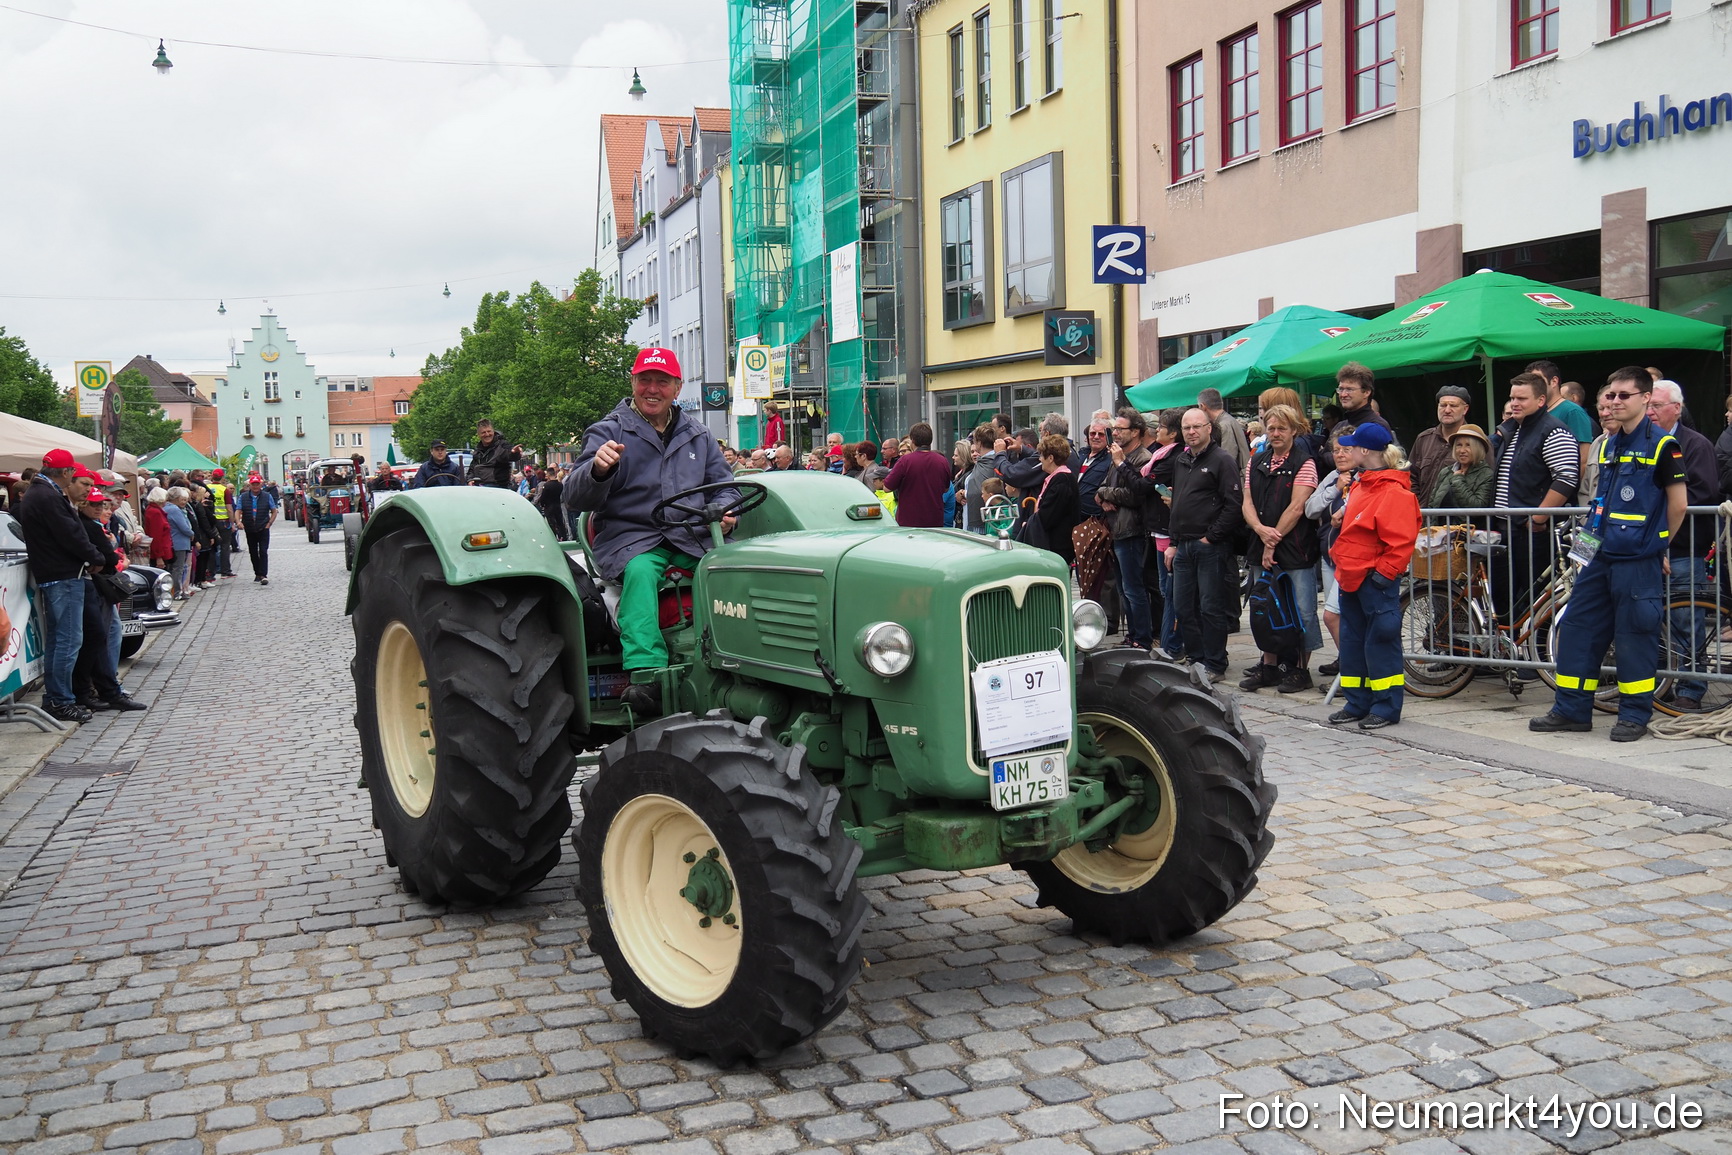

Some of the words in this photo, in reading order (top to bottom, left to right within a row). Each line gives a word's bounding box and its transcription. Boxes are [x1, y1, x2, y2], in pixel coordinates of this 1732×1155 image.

[1572, 92, 1732, 159] Buchhan
[1151, 300, 1169, 311] Unterer
[1169, 296, 1184, 307] Markt
[1184, 293, 1191, 305] 15
[1535, 316, 1645, 327] Lammsbräu
[1537, 310, 1615, 318] Neumarkter
[1065, 325, 1083, 347] G2
[1338, 330, 1429, 351] Lammsbräu
[643, 356, 667, 365] DEKRA
[752, 354, 761, 366] H
[87, 370, 101, 385] H
[1024, 671, 1044, 690] 97
[884, 724, 899, 734] 45
[901, 725, 919, 736] PS
[1006, 760, 1030, 783] NM
[999, 784, 1022, 807] KH
[1026, 780, 1048, 802] 75
